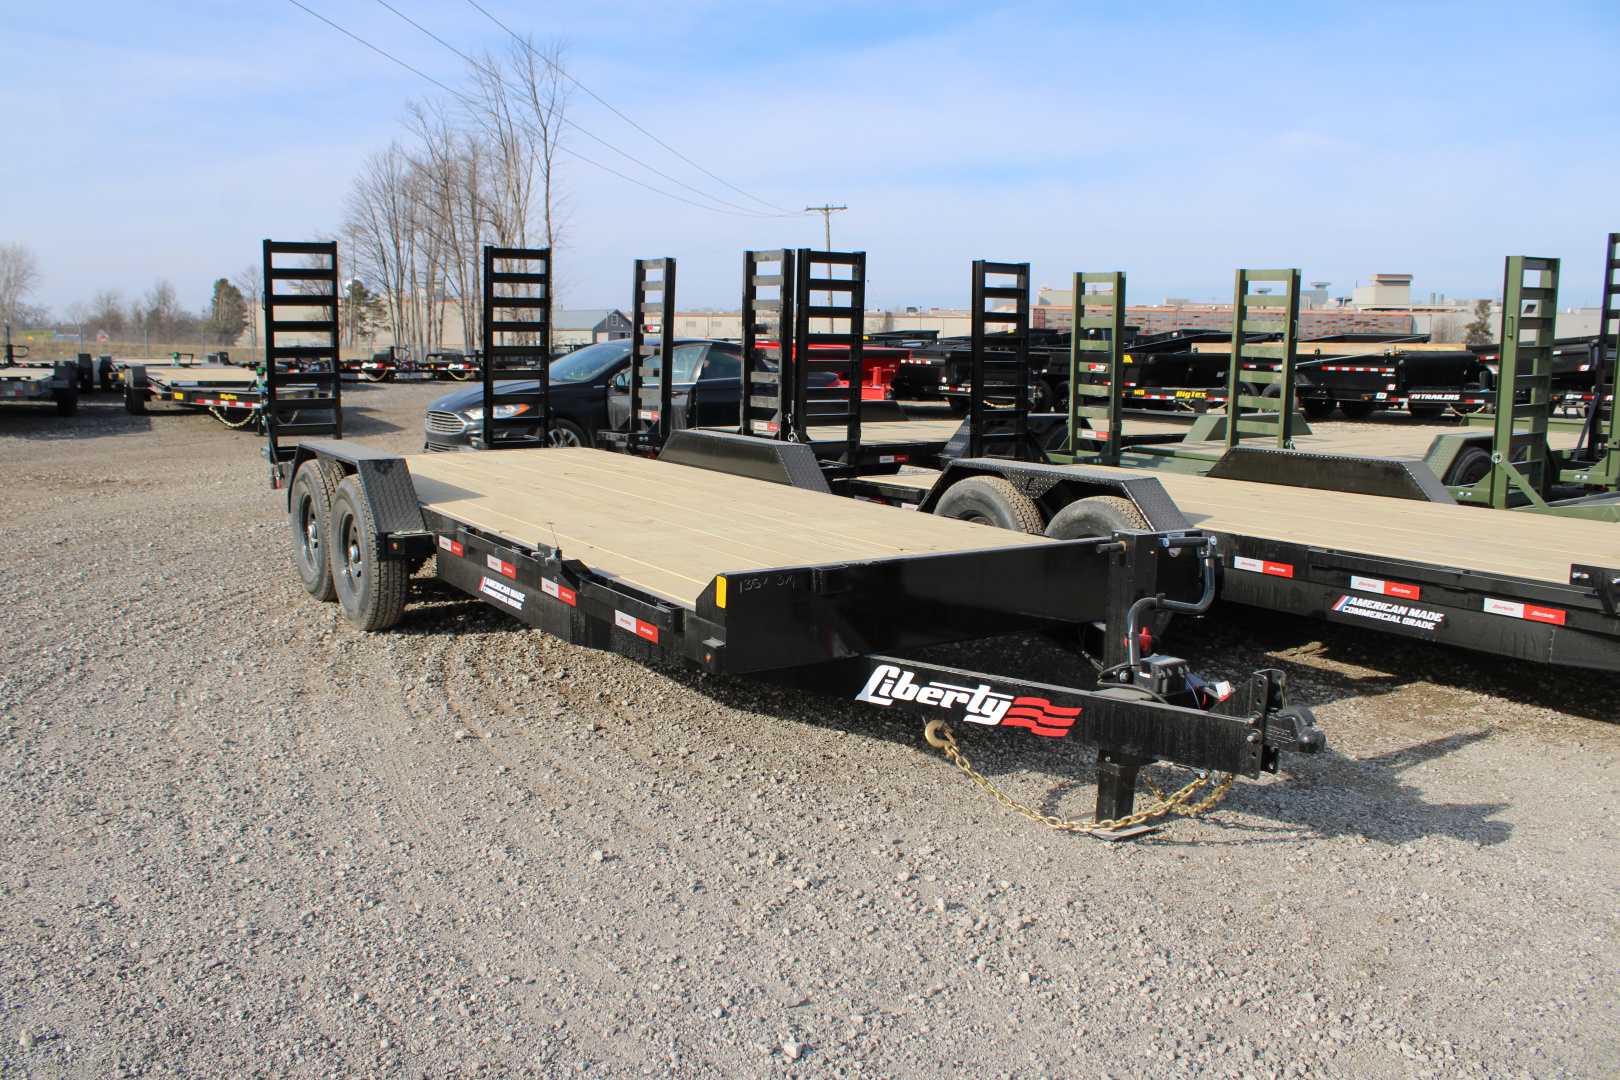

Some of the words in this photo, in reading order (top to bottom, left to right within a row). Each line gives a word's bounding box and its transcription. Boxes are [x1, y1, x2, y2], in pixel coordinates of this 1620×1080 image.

[1341, 606, 1402, 624] COMMERCIAL
[1401, 617, 1436, 630] GRADE
[1348, 597, 1409, 615] AMERICAN
[1407, 607, 1445, 622] MADE
[855, 664, 1014, 726] Liberty
